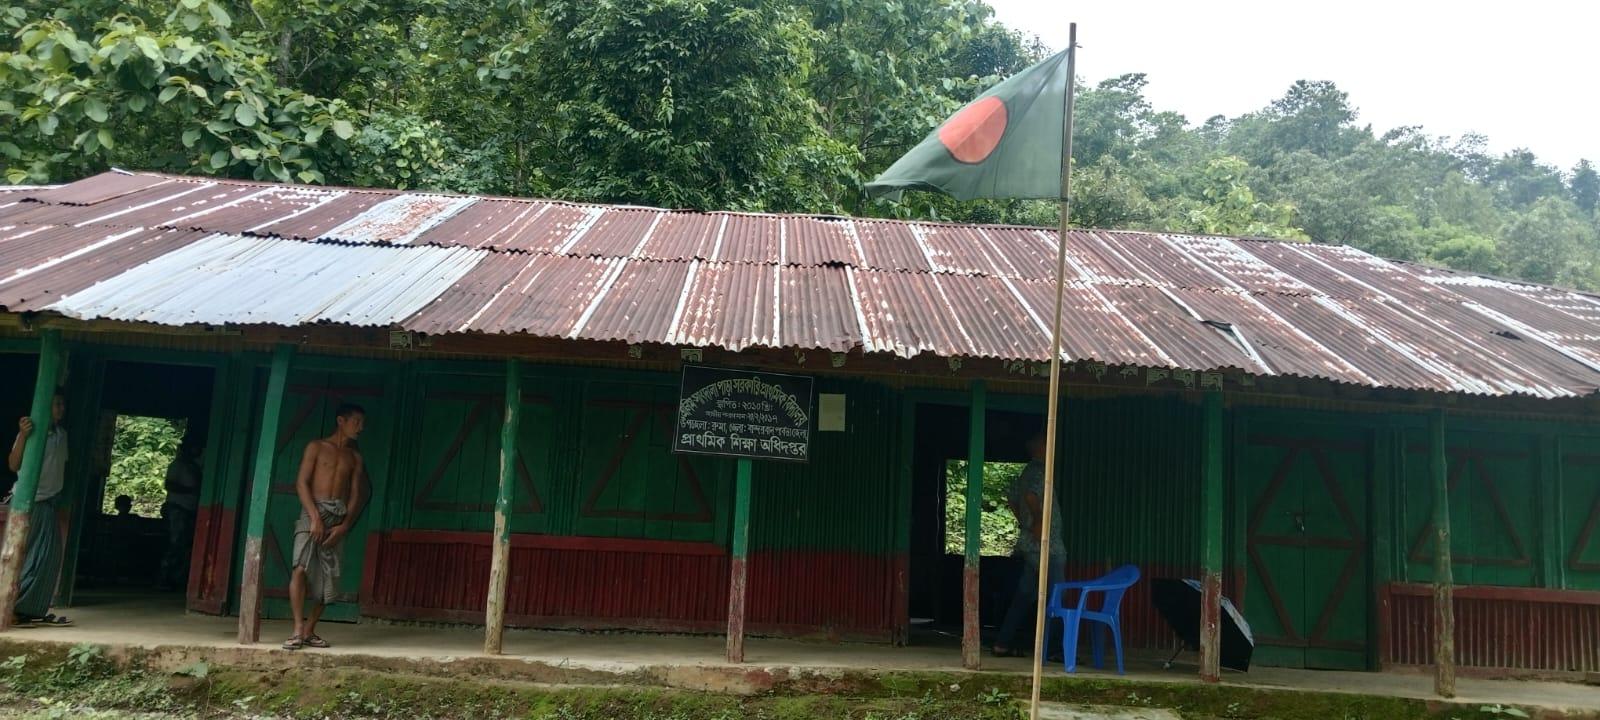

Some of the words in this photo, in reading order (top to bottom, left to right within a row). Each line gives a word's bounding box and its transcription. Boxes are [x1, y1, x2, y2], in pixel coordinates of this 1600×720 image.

[733, 376, 761, 396] সরকারি
[760, 384, 787, 406] প্রাথমিক
[784, 394, 808, 427] বিদ্যালয়
[681, 431, 726, 449] প্রাথমিক
[730, 433, 757, 453] শিক্ষা
[760, 436, 807, 456] অধিদপ্তর
